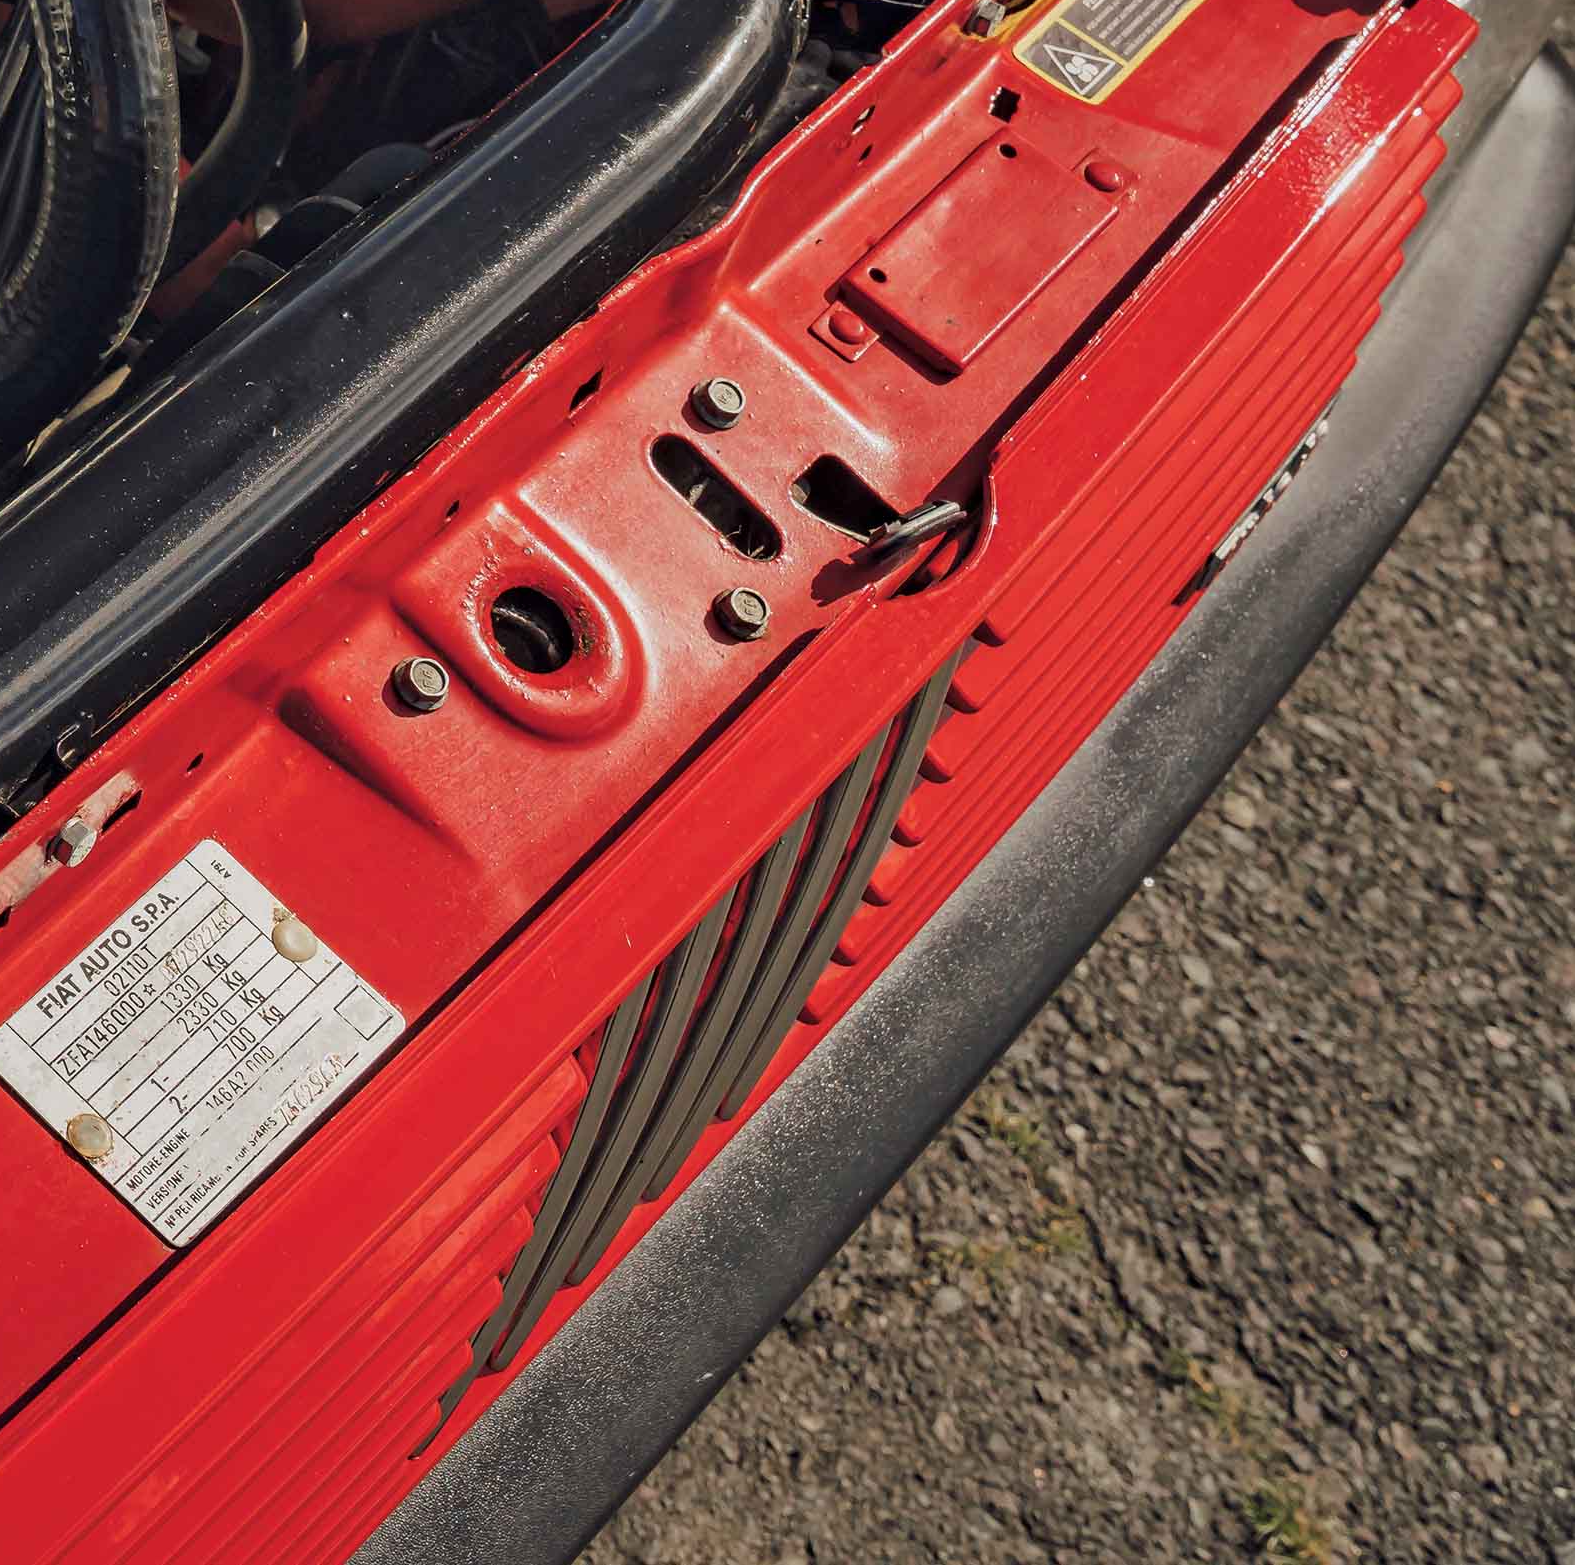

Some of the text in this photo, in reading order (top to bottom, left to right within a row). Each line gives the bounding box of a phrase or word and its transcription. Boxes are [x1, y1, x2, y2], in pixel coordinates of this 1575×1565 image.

[210, 859, 232, 879] A791
[36, 892, 180, 1019] FIAT AUTO S.P.A.
[160, 953, 228, 1014] 1330 Kg
[57, 991, 146, 1077] ZFA146000
[176, 970, 247, 1035] 2330 Kg
[221, 1027, 256, 1060] 700
[257, 1005, 285, 1026] Kg
[150, 988, 266, 1093] 1- 710 Kg
[125, 1128, 190, 1192] MOTORE-ENGINE
